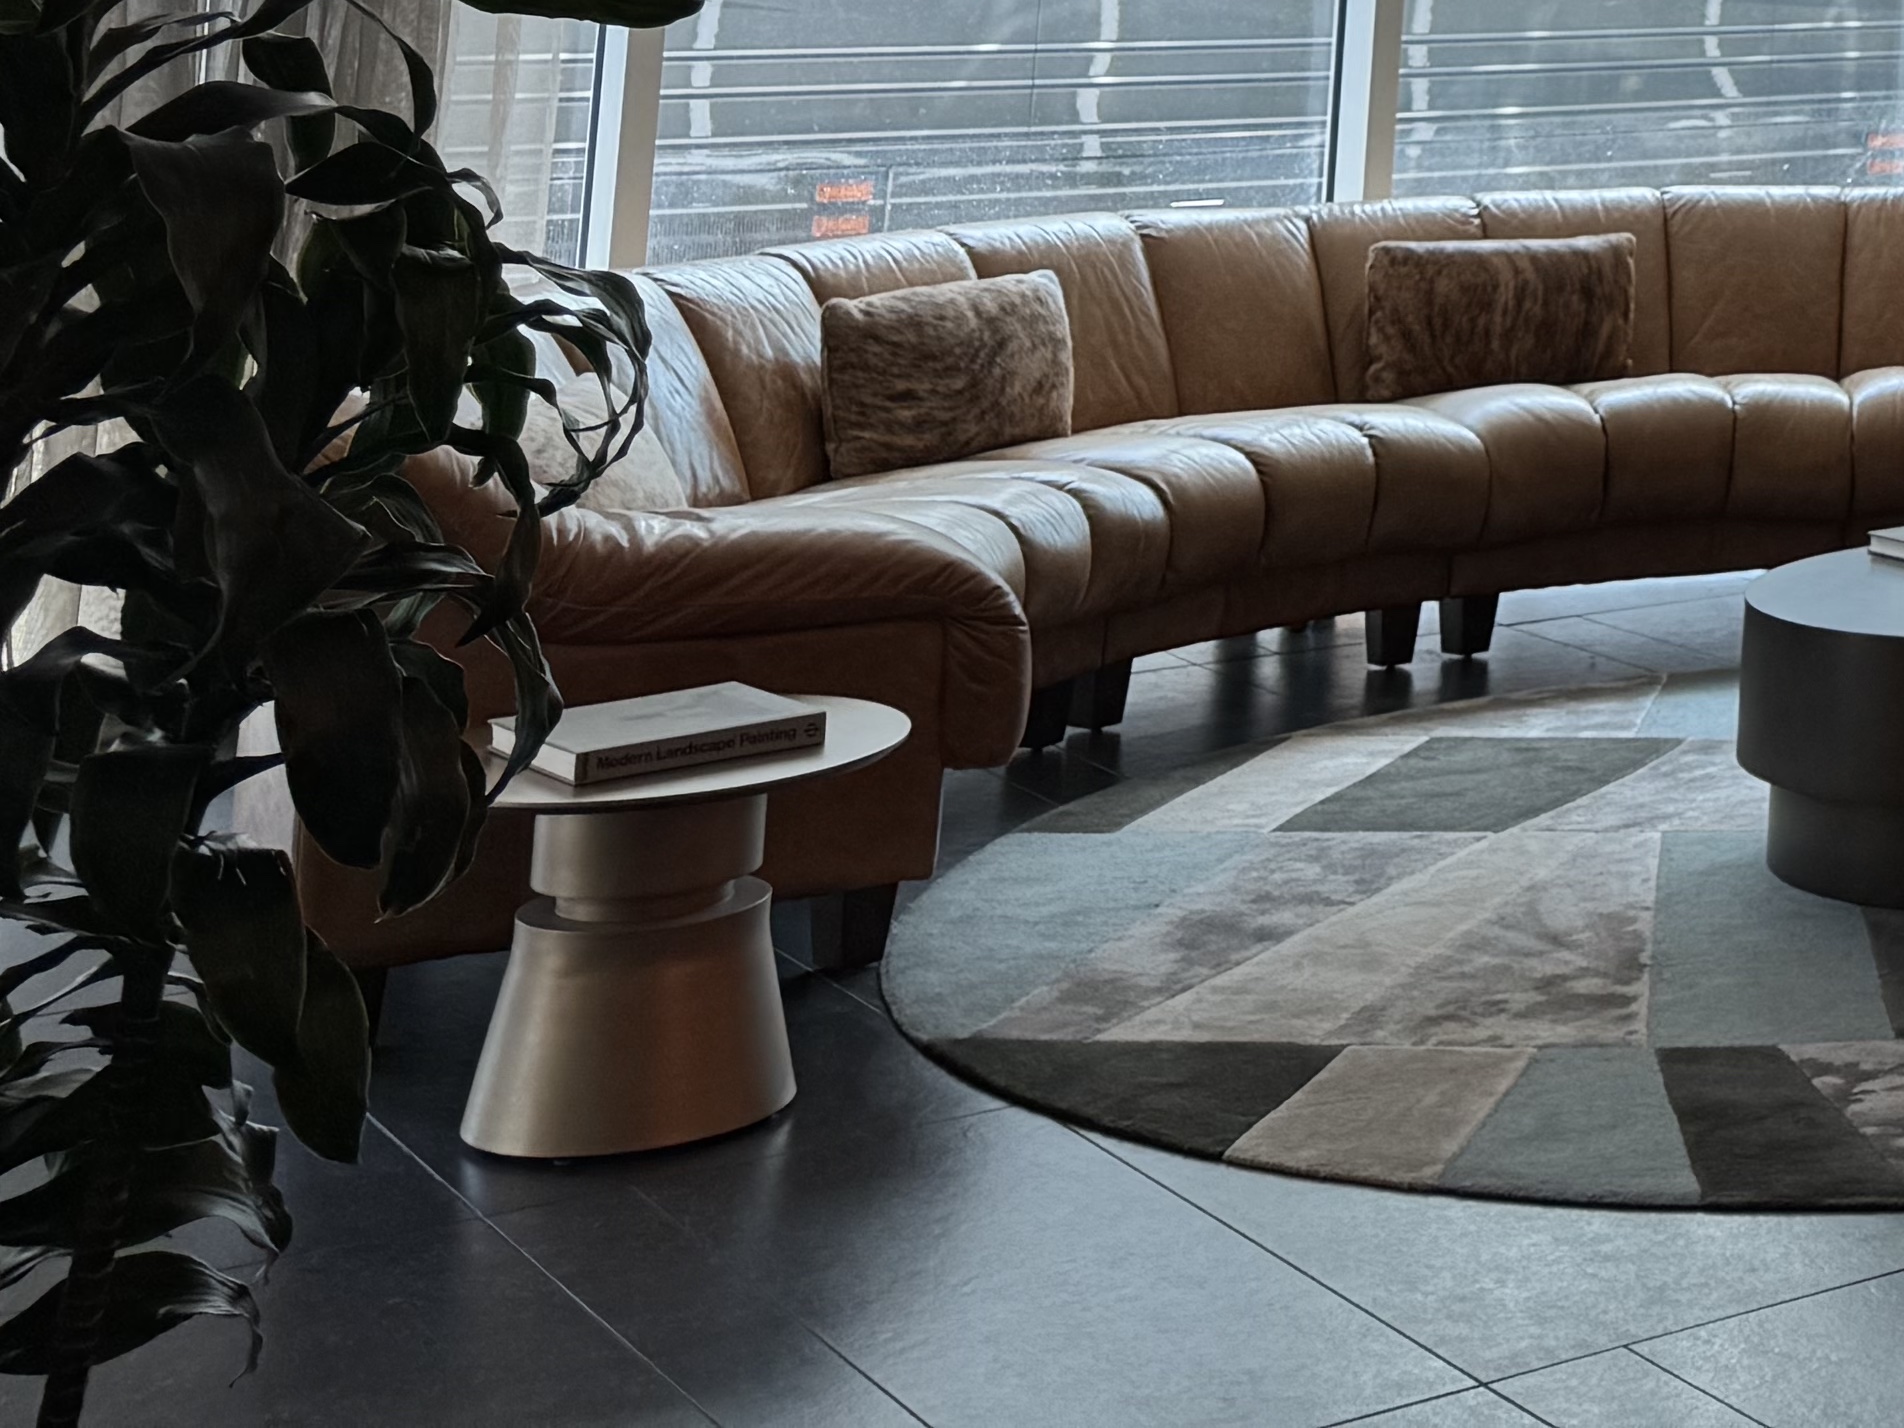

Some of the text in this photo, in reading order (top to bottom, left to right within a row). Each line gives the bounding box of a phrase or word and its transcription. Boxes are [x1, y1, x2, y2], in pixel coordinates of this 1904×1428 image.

[597, 727, 797, 770] Modern Landscape Painting
